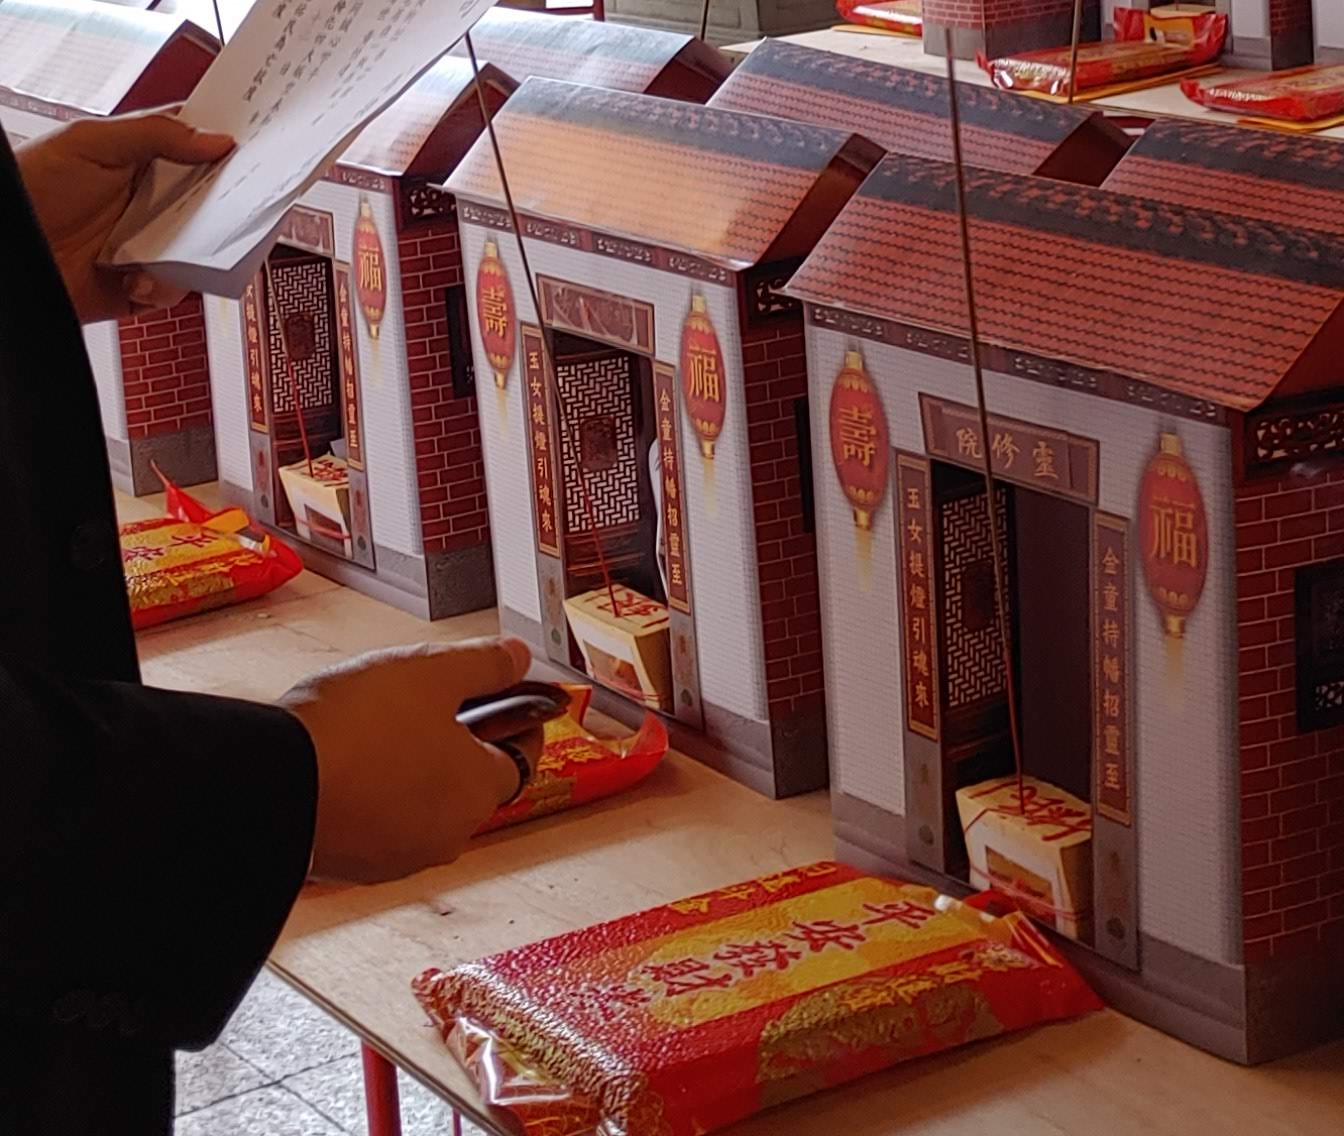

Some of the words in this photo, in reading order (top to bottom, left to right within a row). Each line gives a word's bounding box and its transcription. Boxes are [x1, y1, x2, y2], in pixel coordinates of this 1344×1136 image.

[358, 245, 382, 290] 福
[481, 284, 507, 338] 壽
[688, 346, 720, 402] 福
[838, 406, 876, 468] 壽
[1148, 495, 1199, 567] 福
